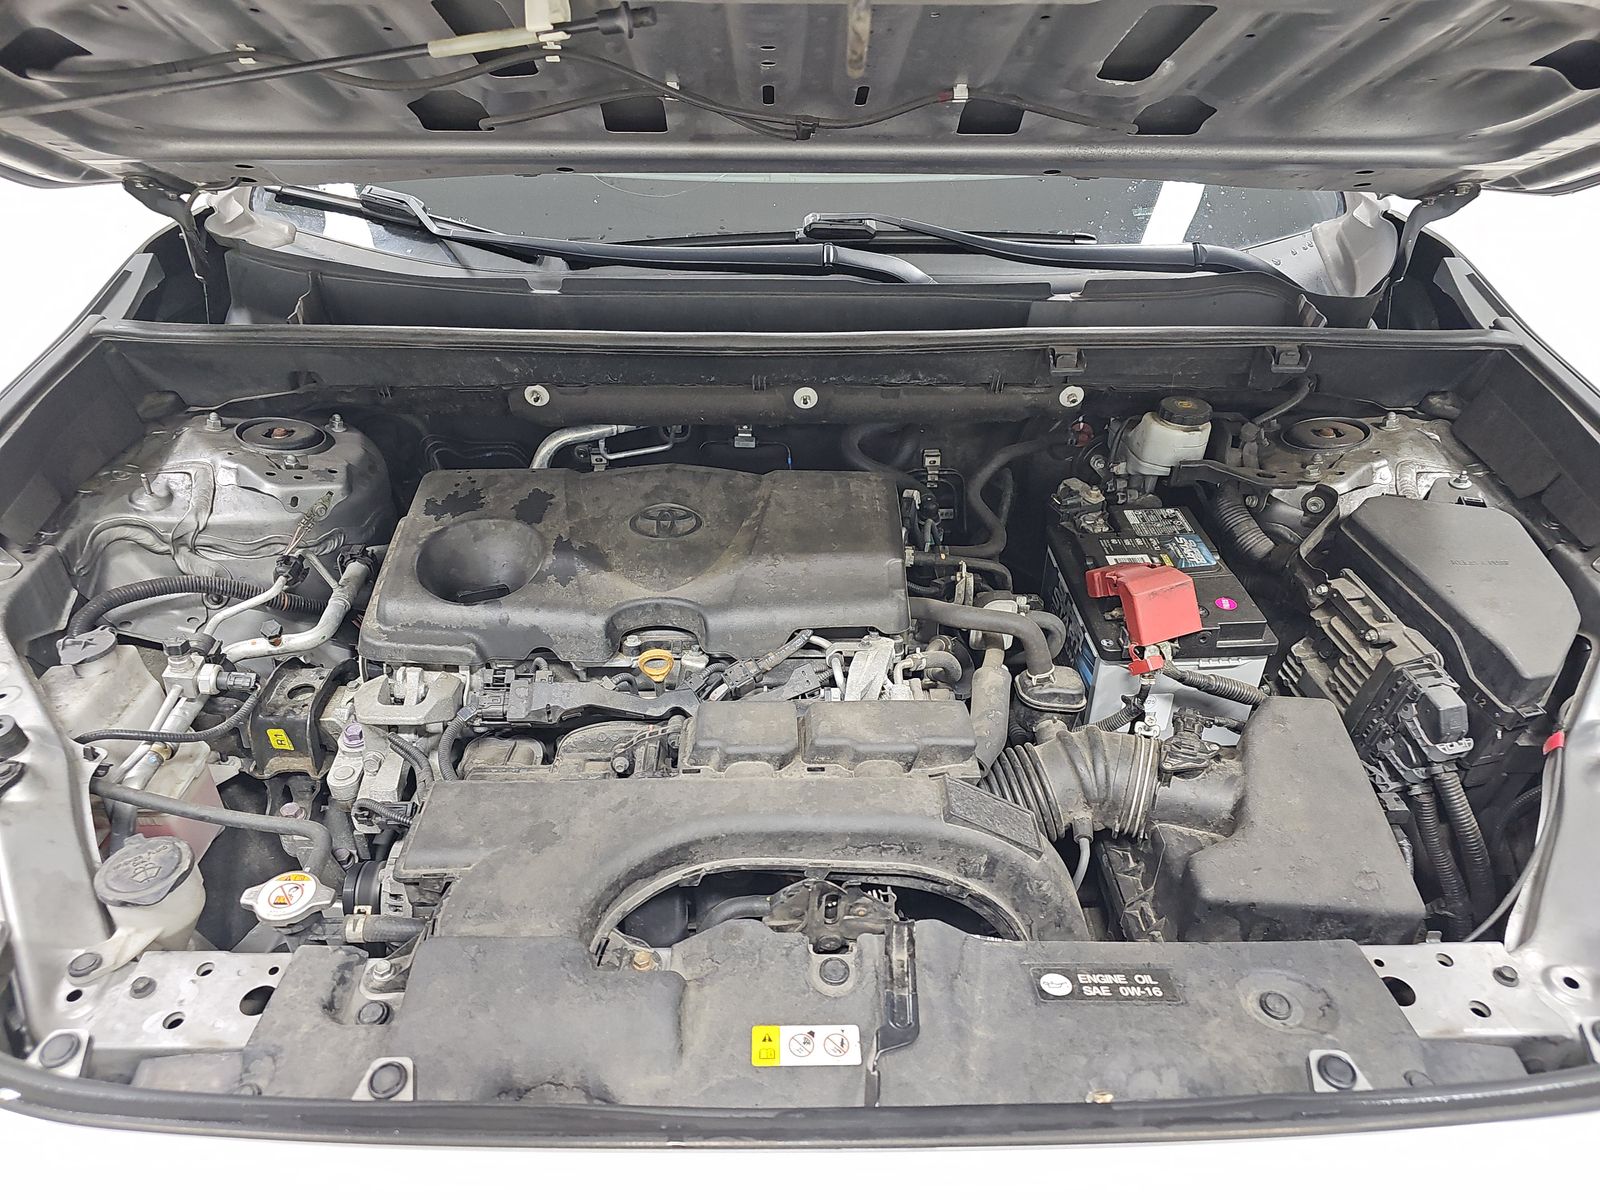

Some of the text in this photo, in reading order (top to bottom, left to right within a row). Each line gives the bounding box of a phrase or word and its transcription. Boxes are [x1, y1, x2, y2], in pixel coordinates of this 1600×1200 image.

[1174, 537, 1198, 563] START
[1473, 692, 1486, 708] L2
[273, 733, 286, 746] R1
[1077, 973, 1159, 985] ENGINE OIL
[1082, 985, 1164, 998] SAE 0W-16
